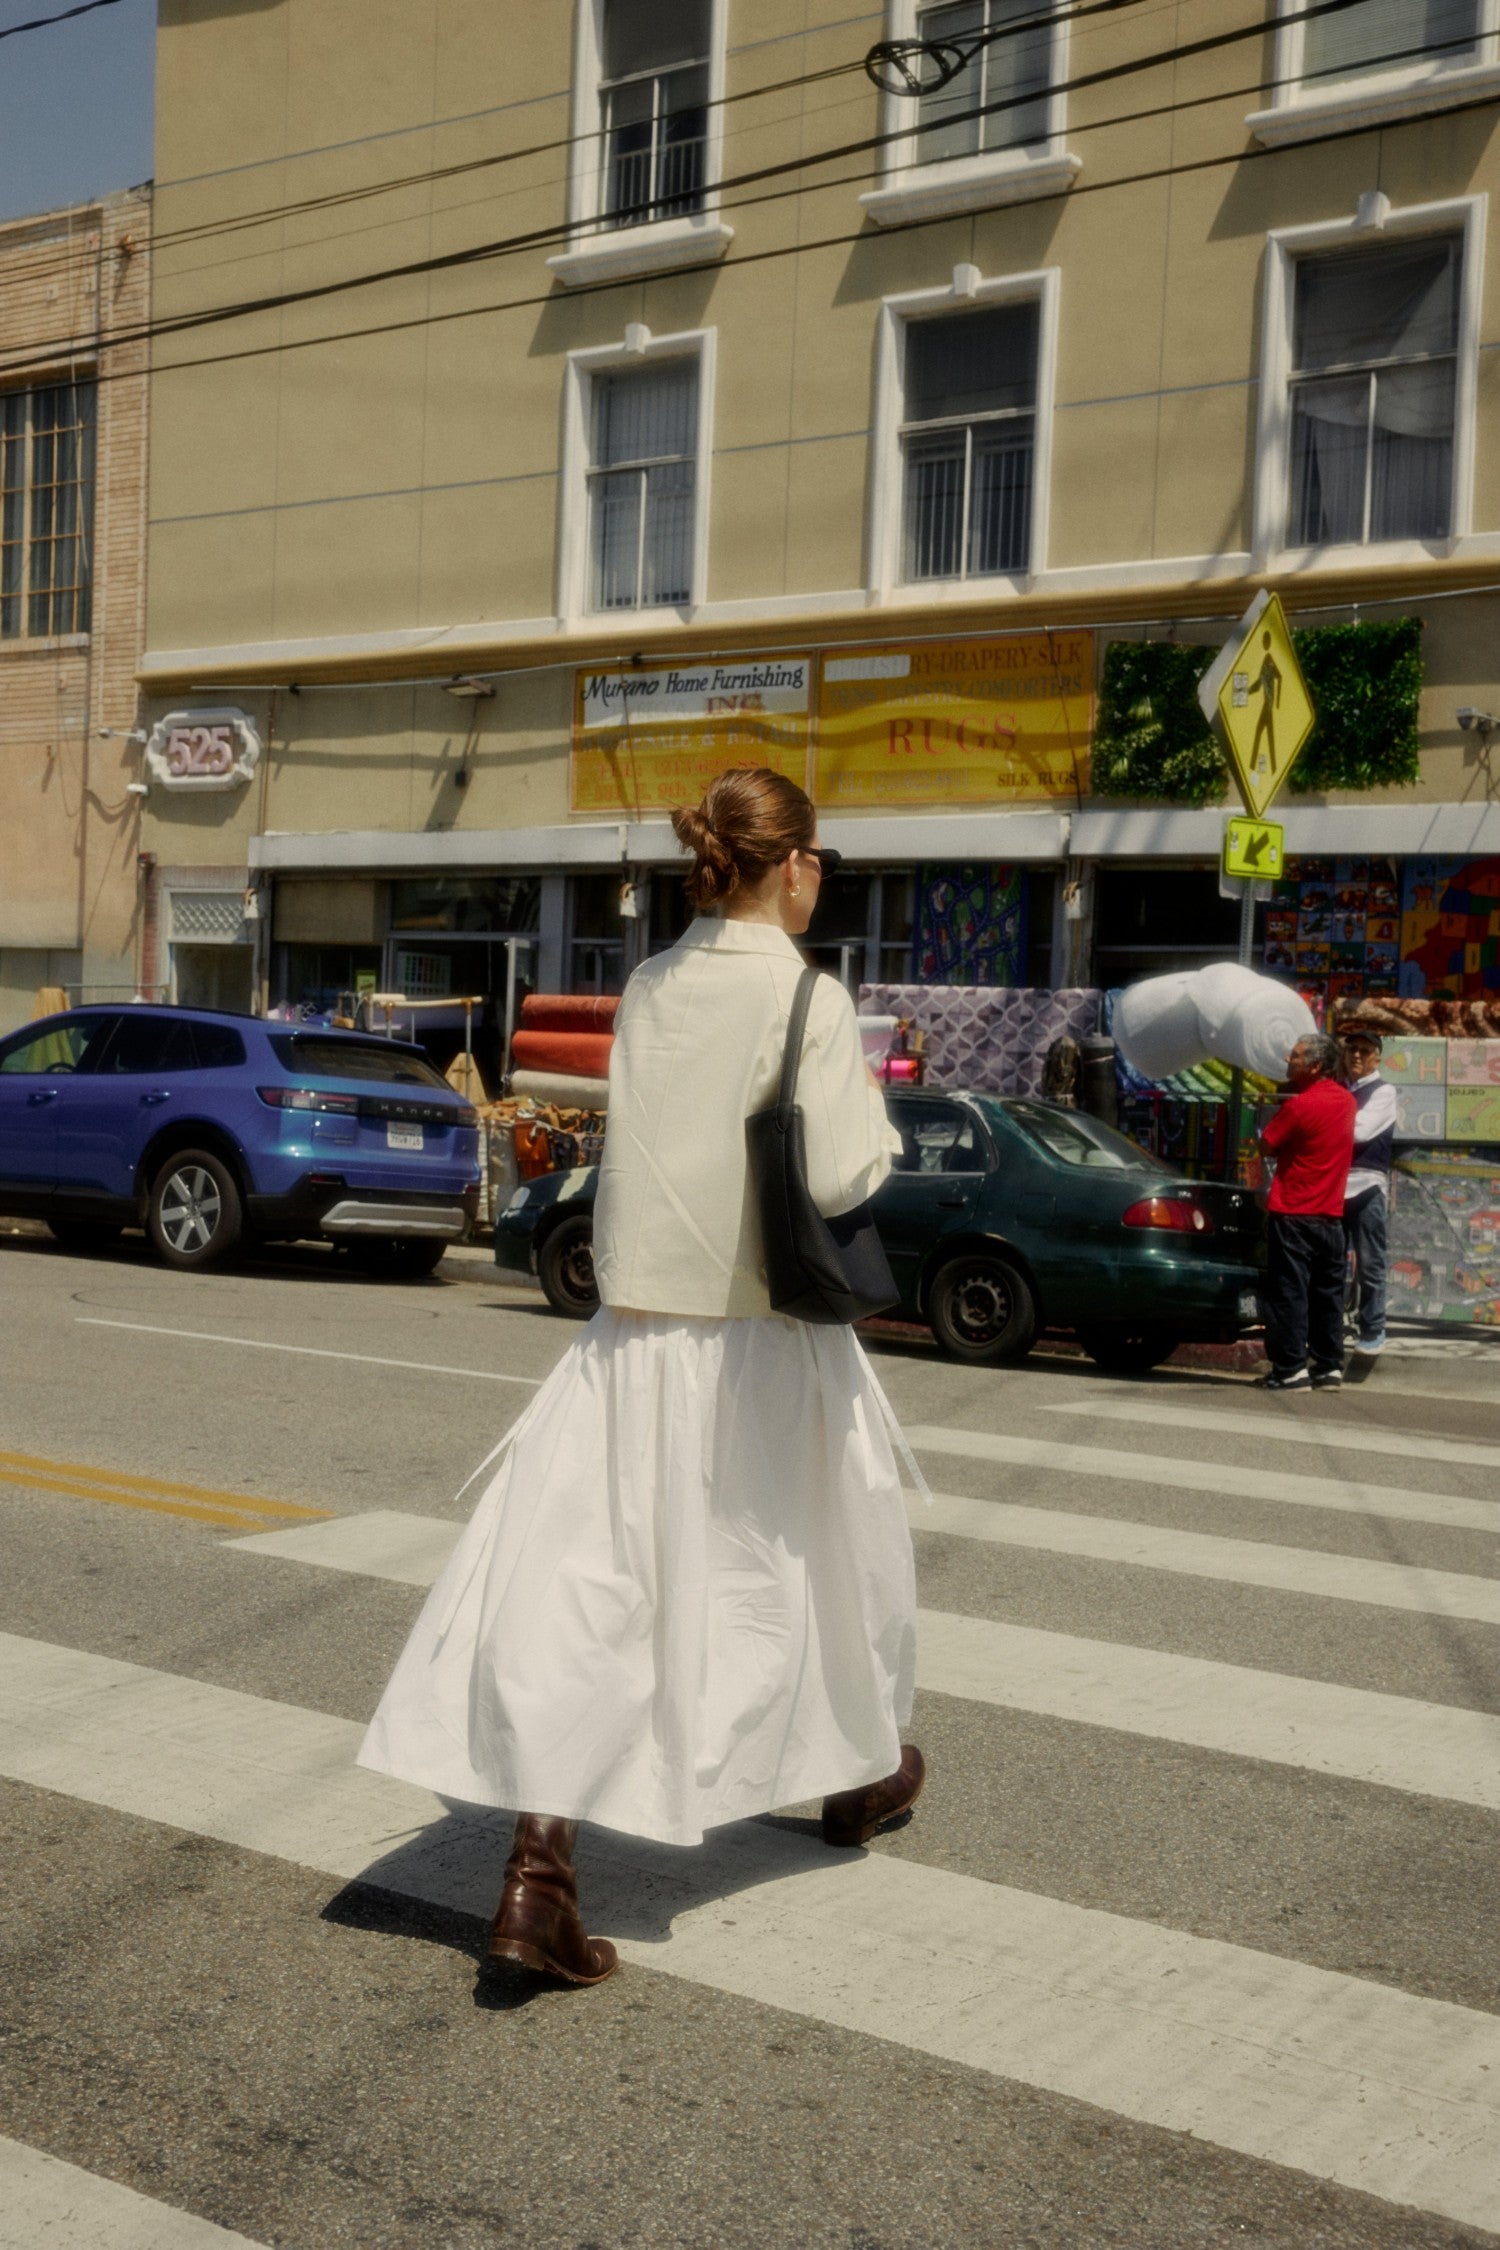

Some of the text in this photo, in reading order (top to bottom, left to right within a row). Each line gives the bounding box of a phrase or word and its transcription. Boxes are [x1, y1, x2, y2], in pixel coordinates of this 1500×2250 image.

[581, 665, 803, 707] Murano Home Furnishing
[701, 729, 715, 747] &
[887, 712, 1017, 756] RUGS
[169, 727, 234, 774] 525
[998, 769, 1078, 787] SILK RUGS
[1419, 1056, 1442, 1081] H
[1449, 1087, 1486, 1096] carrot
[1417, 1112, 1441, 1136] D
